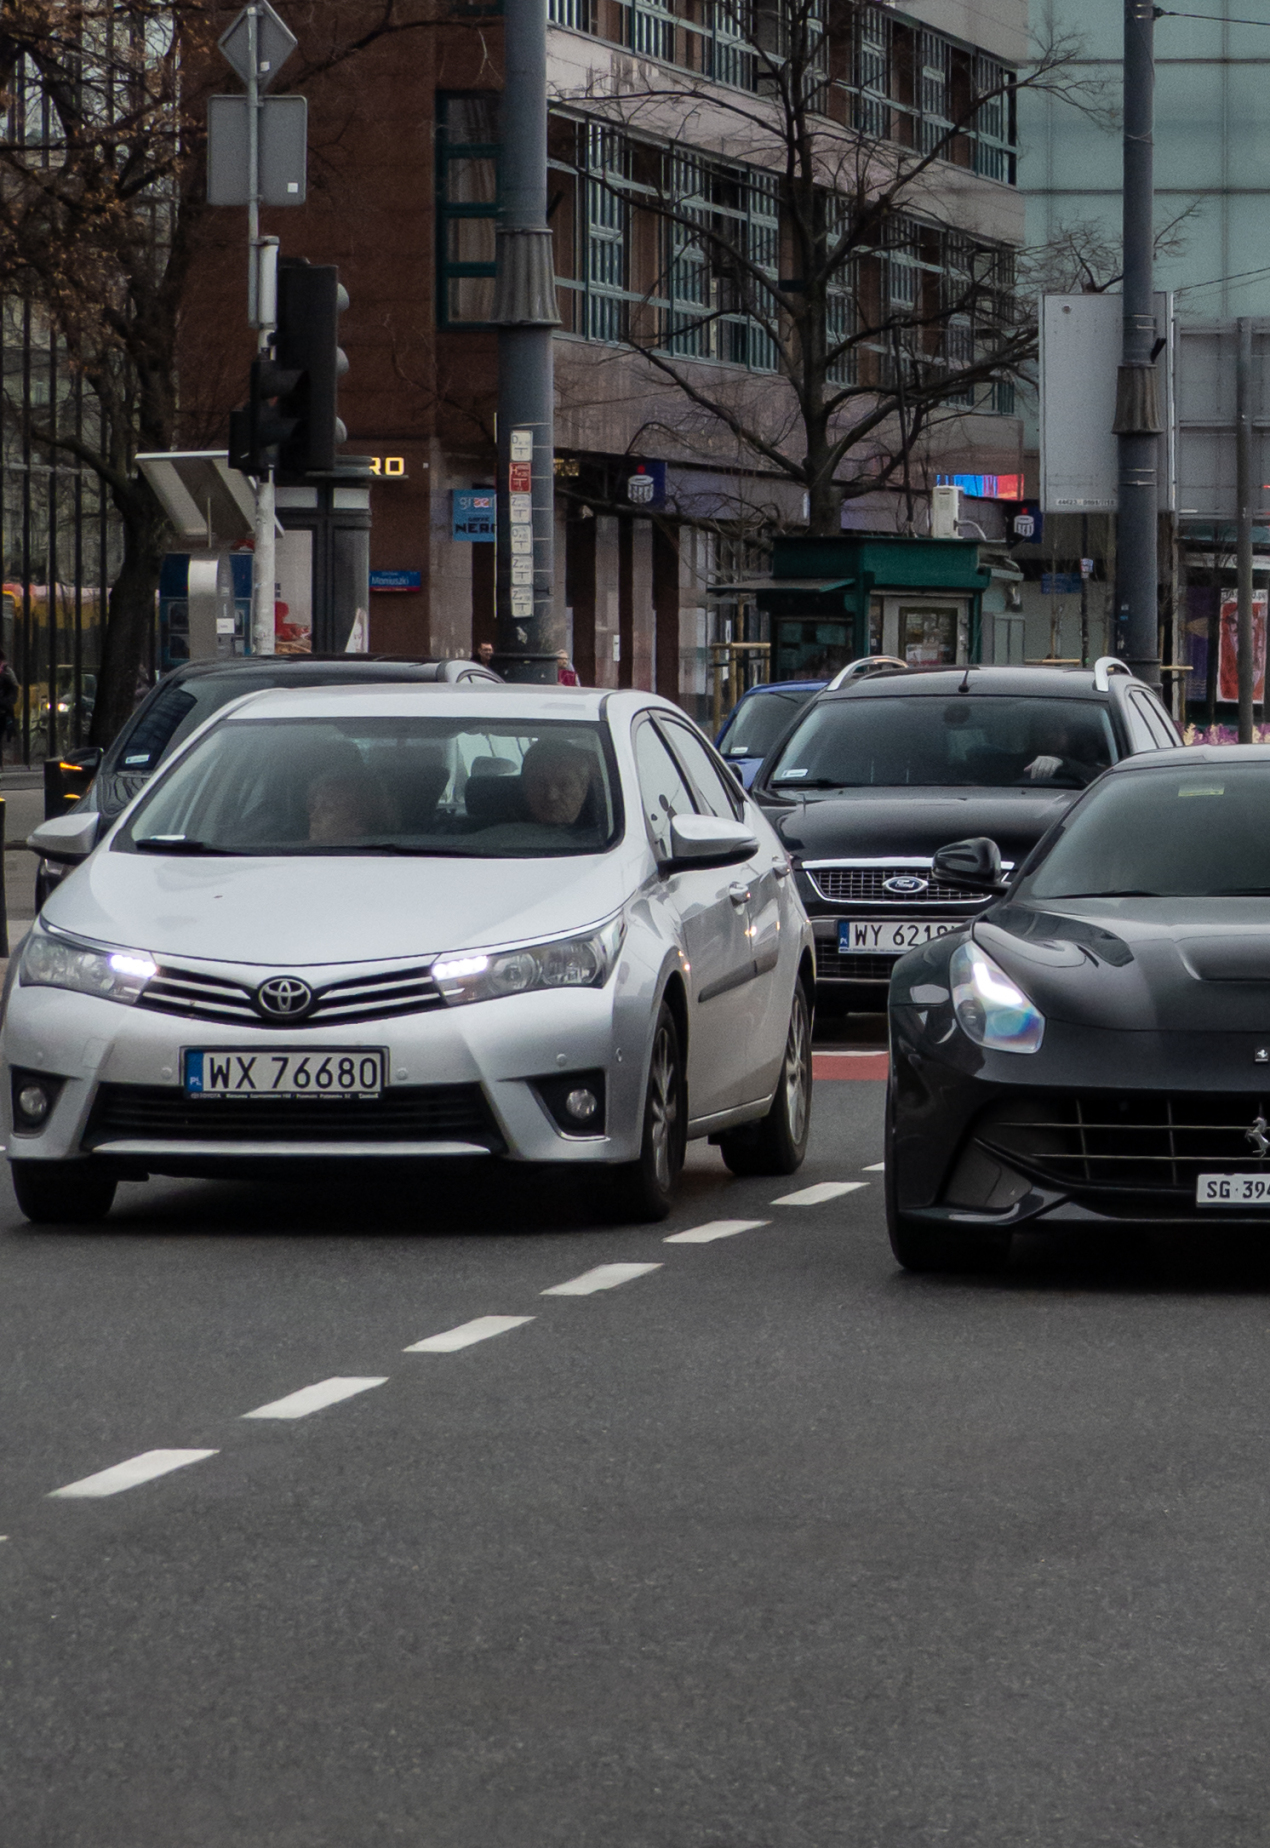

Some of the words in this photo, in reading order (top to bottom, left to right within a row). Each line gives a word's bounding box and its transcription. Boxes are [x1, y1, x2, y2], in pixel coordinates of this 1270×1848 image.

[855, 924, 883, 946] WY
[210, 1056, 257, 1089] WX
[271, 1056, 378, 1089] 76680
[1206, 1180, 1231, 1199] SG
